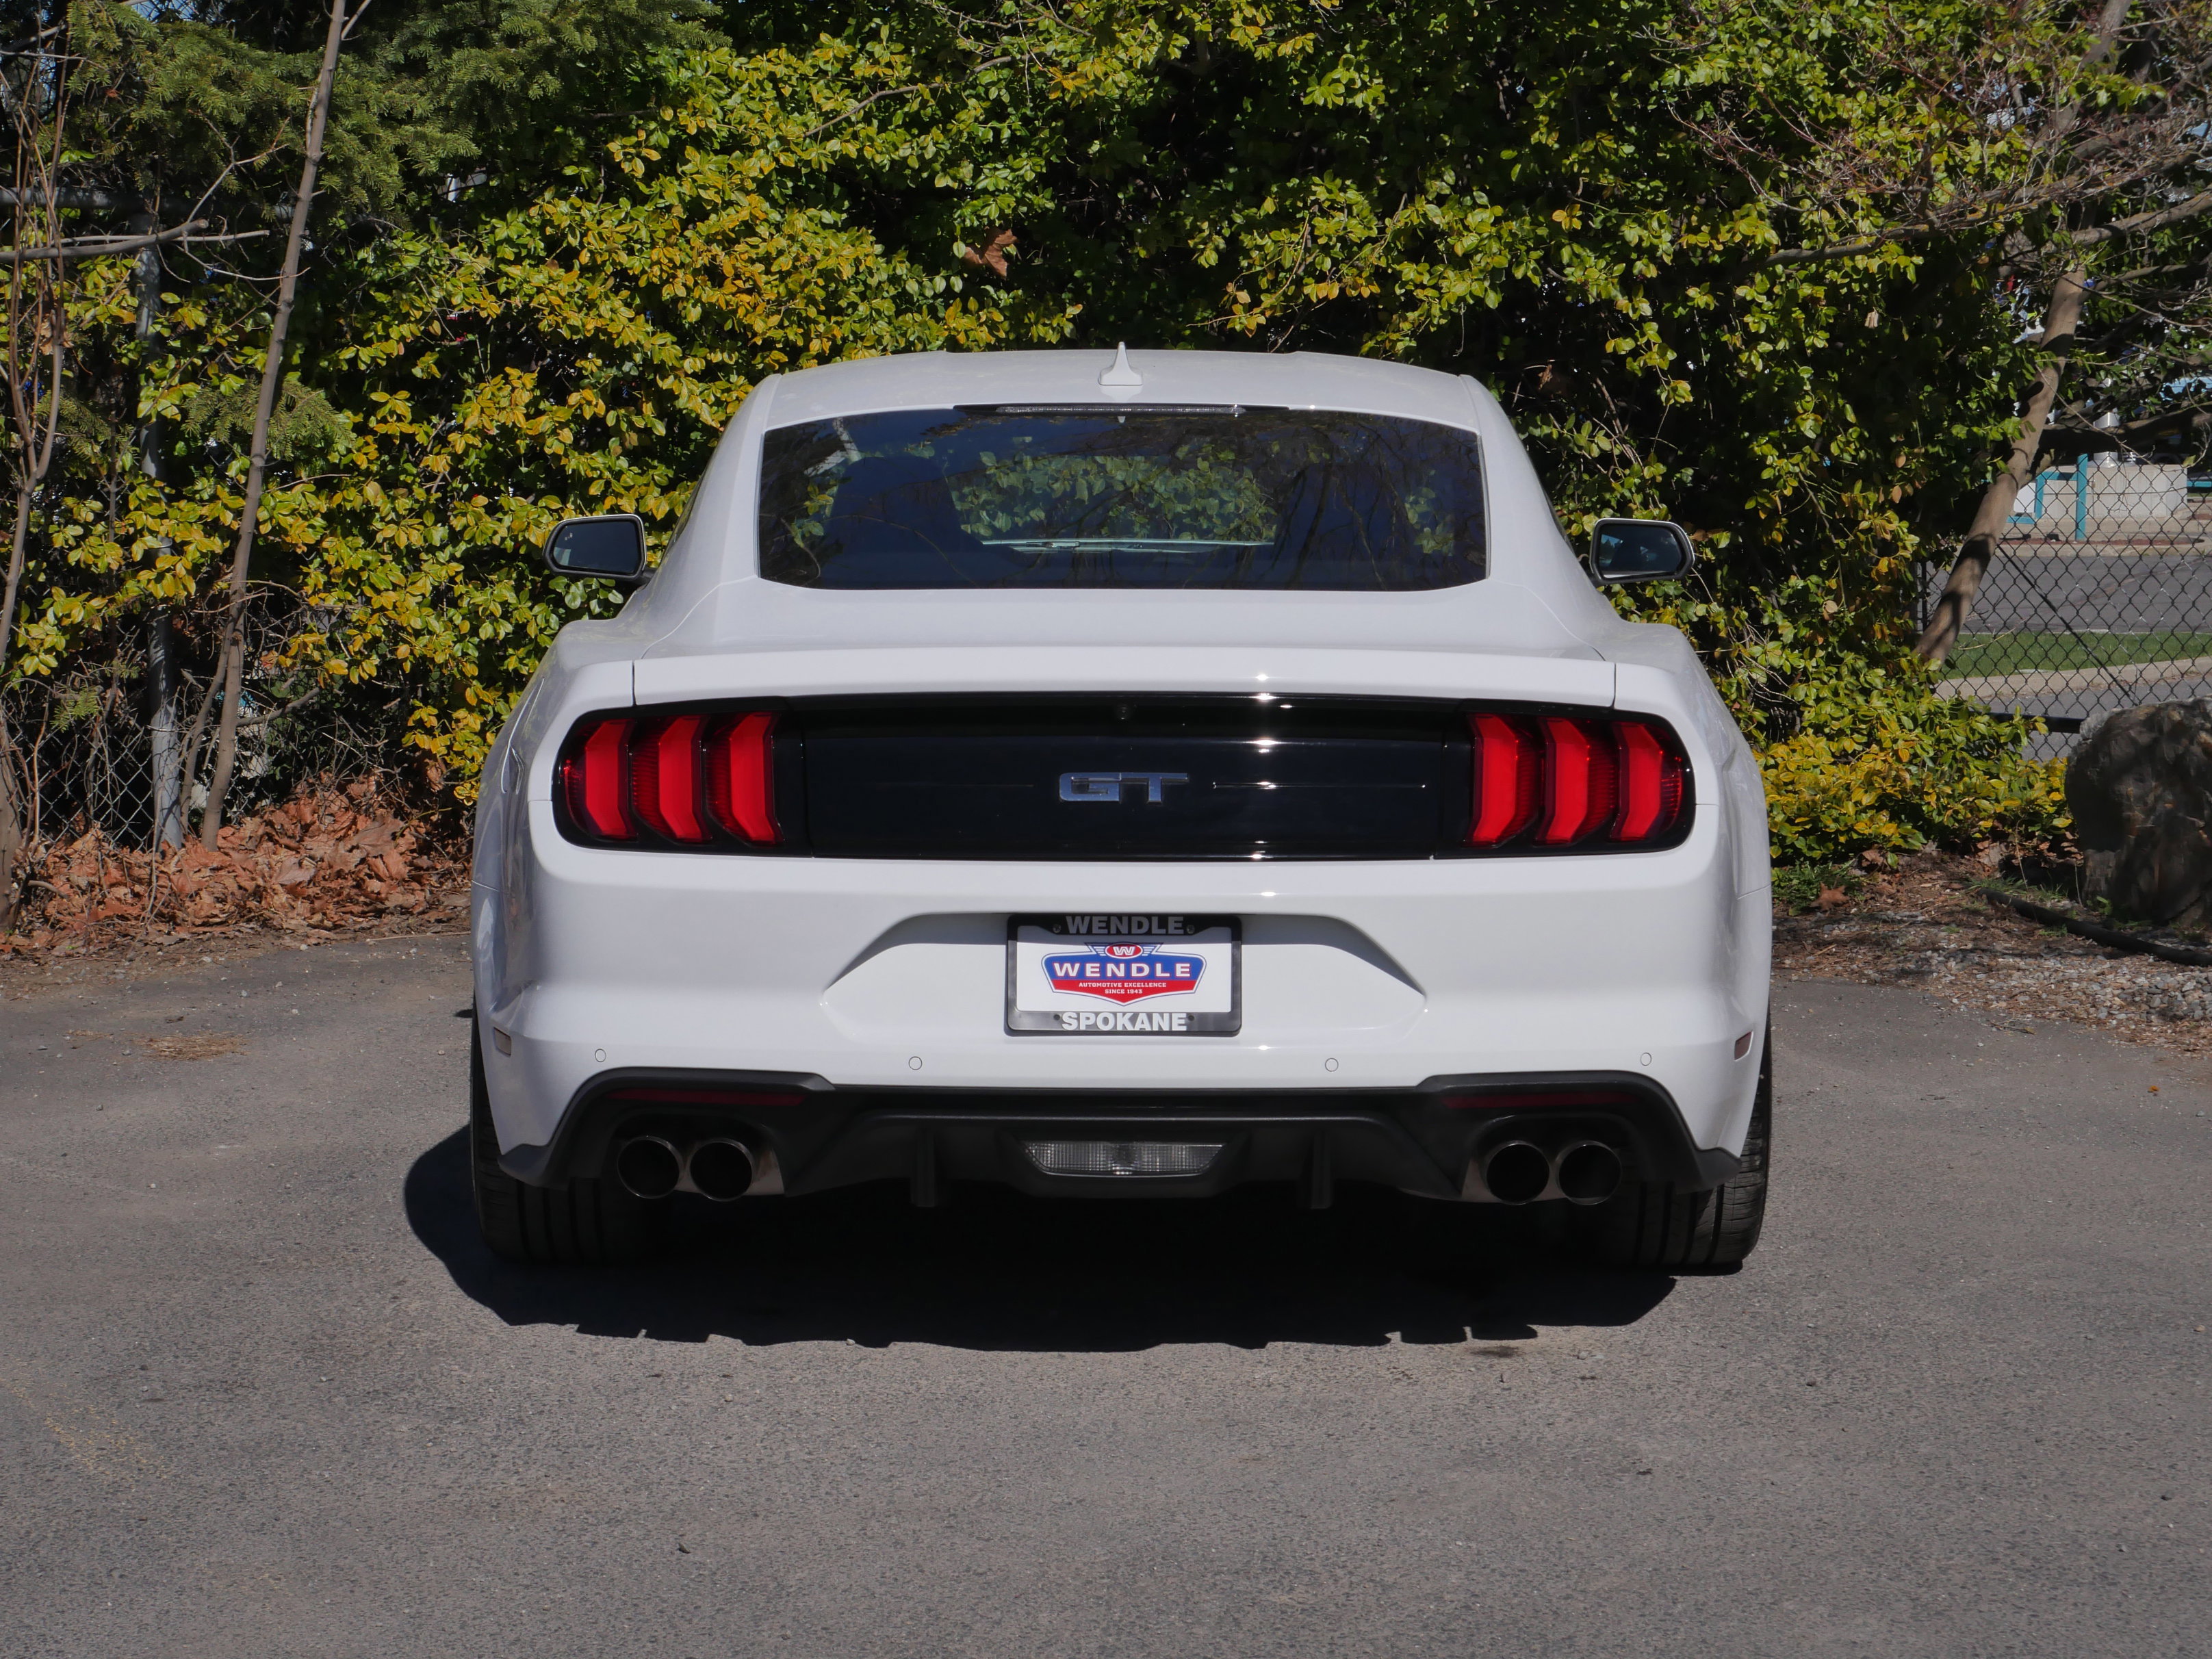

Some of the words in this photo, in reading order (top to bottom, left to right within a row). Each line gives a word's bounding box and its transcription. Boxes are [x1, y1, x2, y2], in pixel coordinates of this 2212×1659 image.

[1059, 771, 1188, 803] GT
[1066, 916, 1184, 935] WENDLE
[1112, 947, 1135, 956] W
[1053, 963, 1190, 977] WENDLE
[1062, 1012, 1187, 1031] SPOKANE
